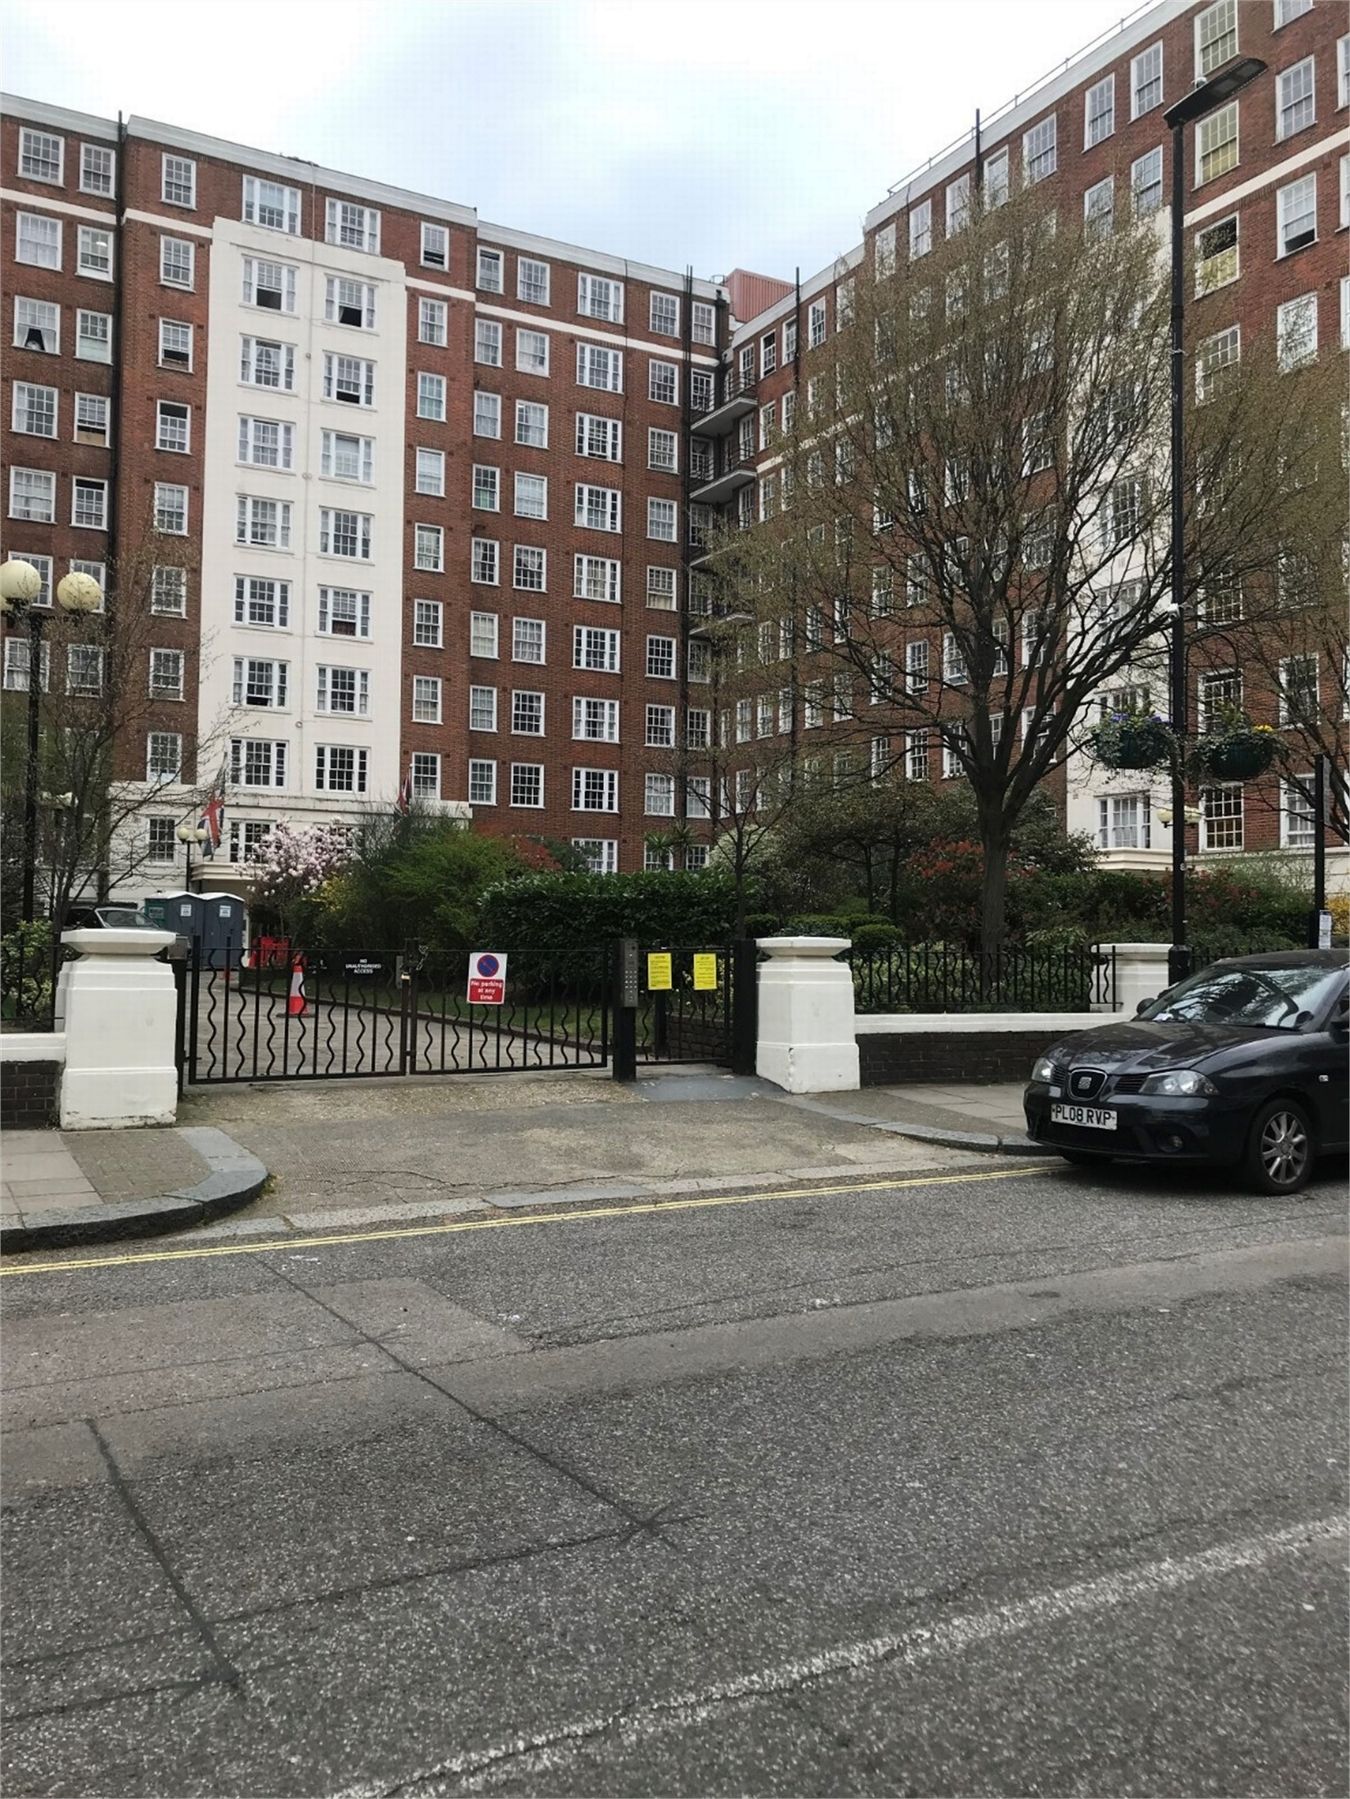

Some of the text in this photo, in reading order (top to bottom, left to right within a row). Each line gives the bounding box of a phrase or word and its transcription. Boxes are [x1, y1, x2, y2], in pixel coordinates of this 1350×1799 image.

[481, 980, 502, 988] parking
[1055, 1105, 1111, 1126] PL08 RVP
